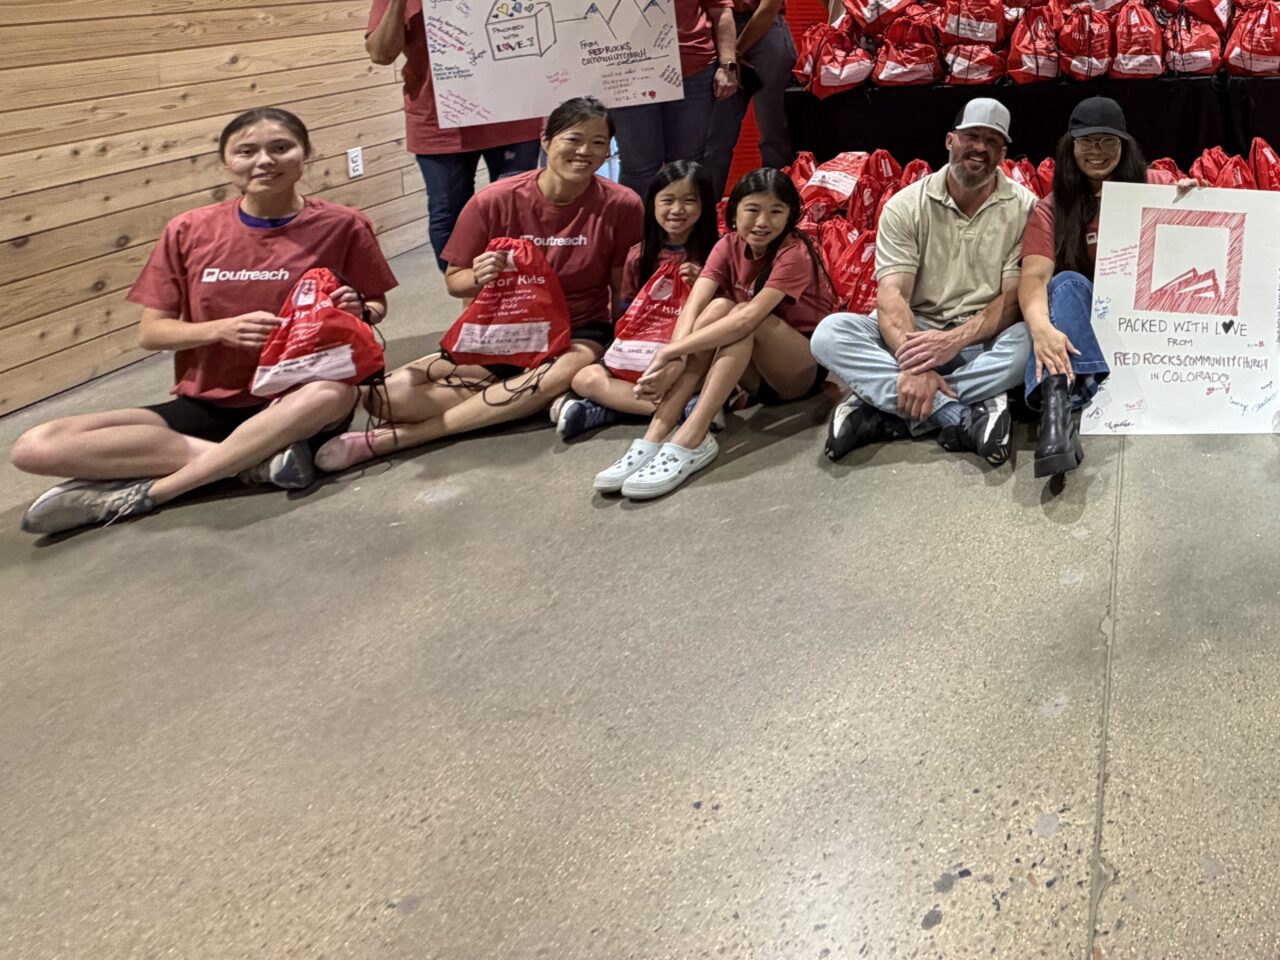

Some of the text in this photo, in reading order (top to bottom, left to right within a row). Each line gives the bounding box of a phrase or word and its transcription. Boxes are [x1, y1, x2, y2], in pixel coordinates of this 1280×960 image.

[605, 41, 632, 54] ROCKS
[533, 234, 588, 246] outreach
[218, 268, 289, 280] outreach
[662, 305, 682, 316] Kid
[1118, 317, 1167, 333] PACKED
[1174, 320, 1209, 334] WITH
[1167, 337, 1193, 347] FROM
[1114, 352, 1141, 366] RED
[1143, 352, 1182, 366] ROCKS
[1183, 355, 1237, 368] COMMUNITY
[1150, 369, 1230, 384] IN COLORADO
